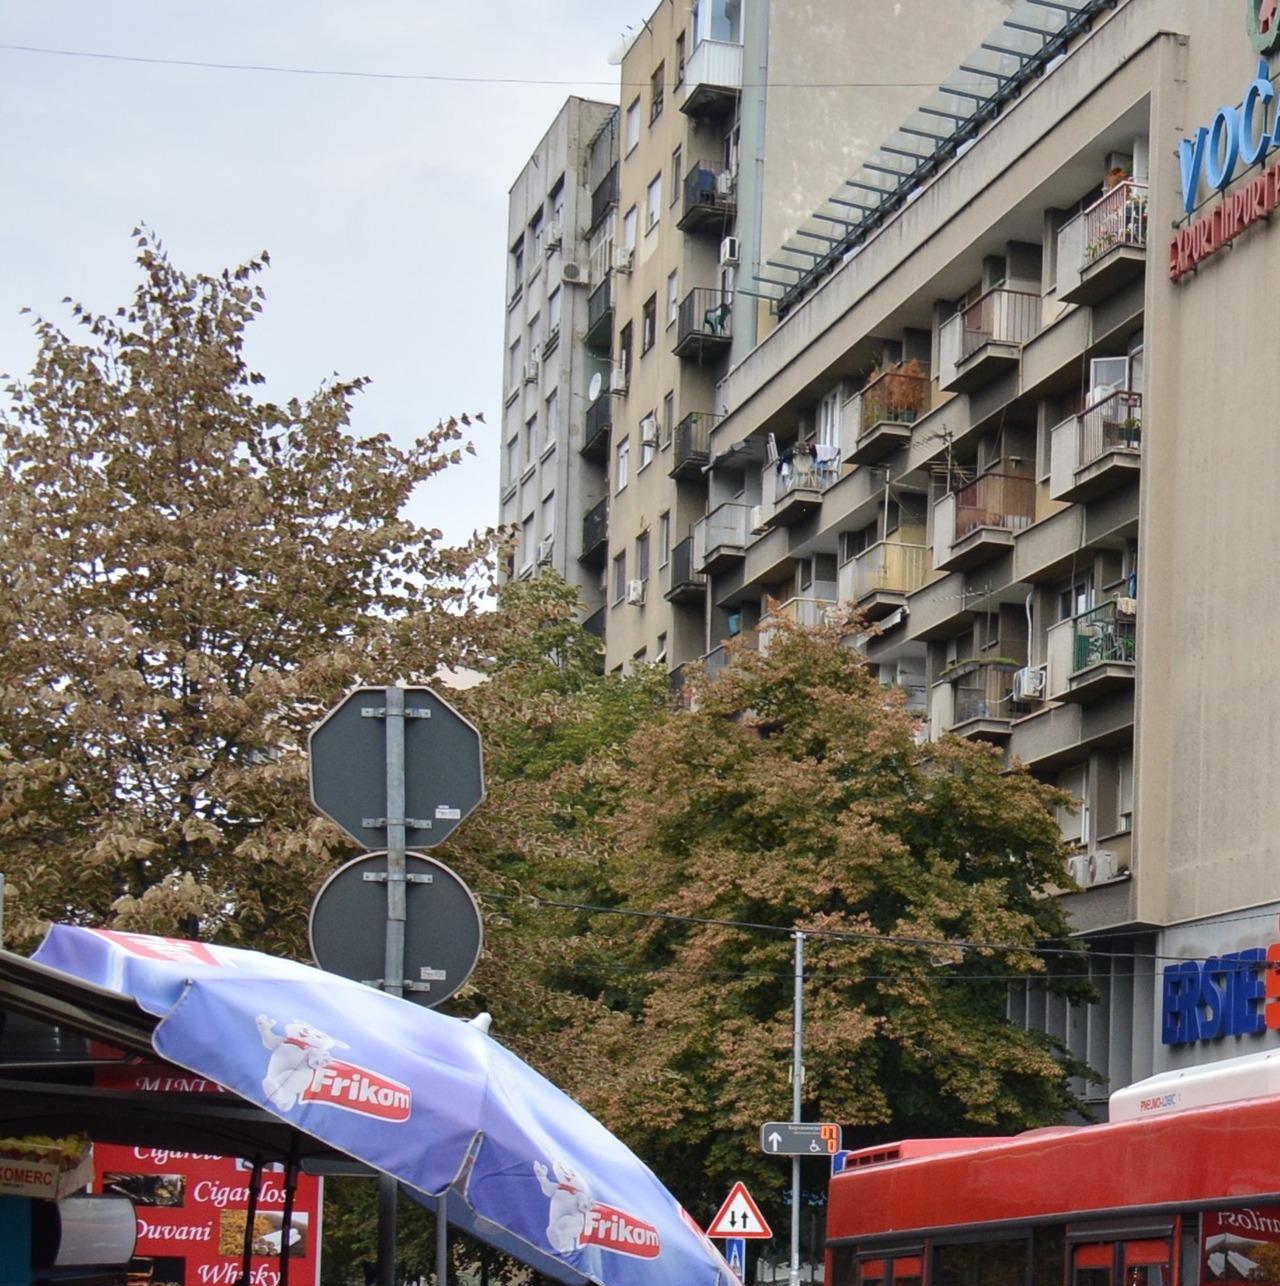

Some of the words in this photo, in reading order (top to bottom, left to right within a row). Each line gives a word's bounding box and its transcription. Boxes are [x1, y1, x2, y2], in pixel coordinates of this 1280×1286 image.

[1168, 206, 1222, 283] EXPORT
[1219, 166, 1276, 243] IMPORT
[1162, 947, 1267, 1045] ERSTE
